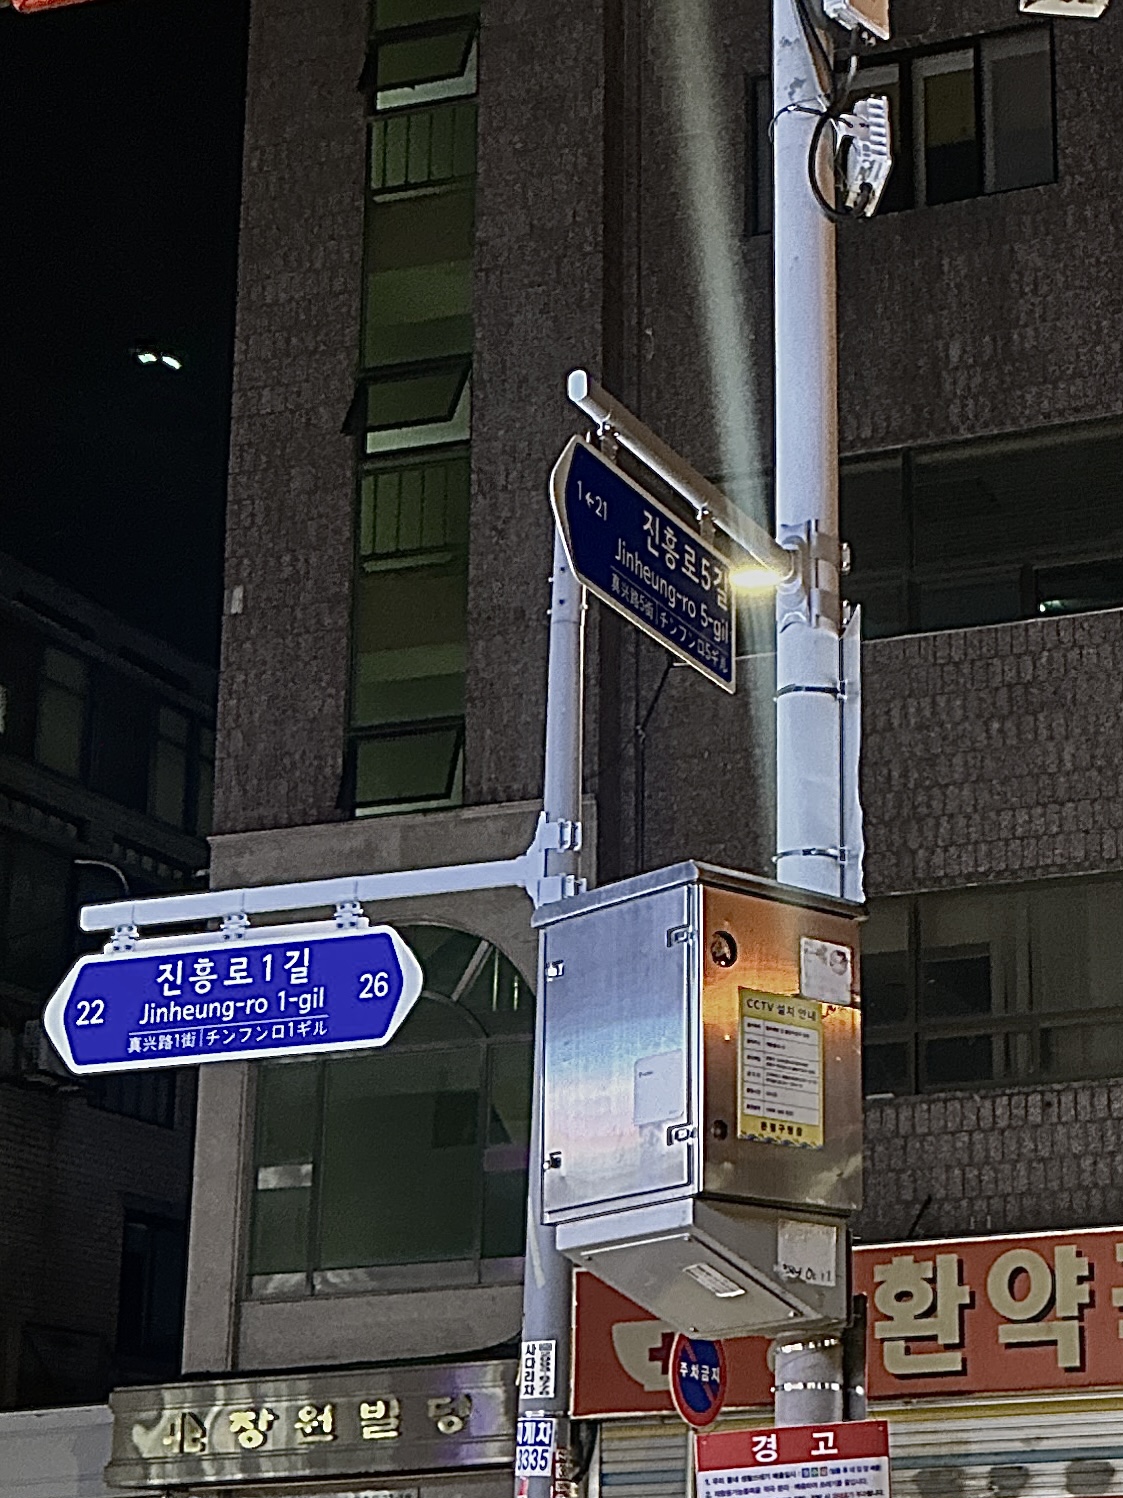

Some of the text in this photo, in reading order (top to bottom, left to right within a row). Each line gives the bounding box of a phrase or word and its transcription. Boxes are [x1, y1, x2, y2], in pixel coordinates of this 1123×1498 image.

[643, 509, 729, 612] 진흥로5길
[615, 538, 729, 645] Jinheung-ro 5-gil
[155, 947, 311, 998] 진흥로1길
[359, 973, 389, 999] 26
[76, 1000, 105, 1026] 22
[139, 986, 325, 1026] Jinheung-ro 1-gil
[746, 999, 775, 1012] CCTV
[797, 1008, 817, 1021] 안내
[679, 1361, 721, 1383] 주차금지
